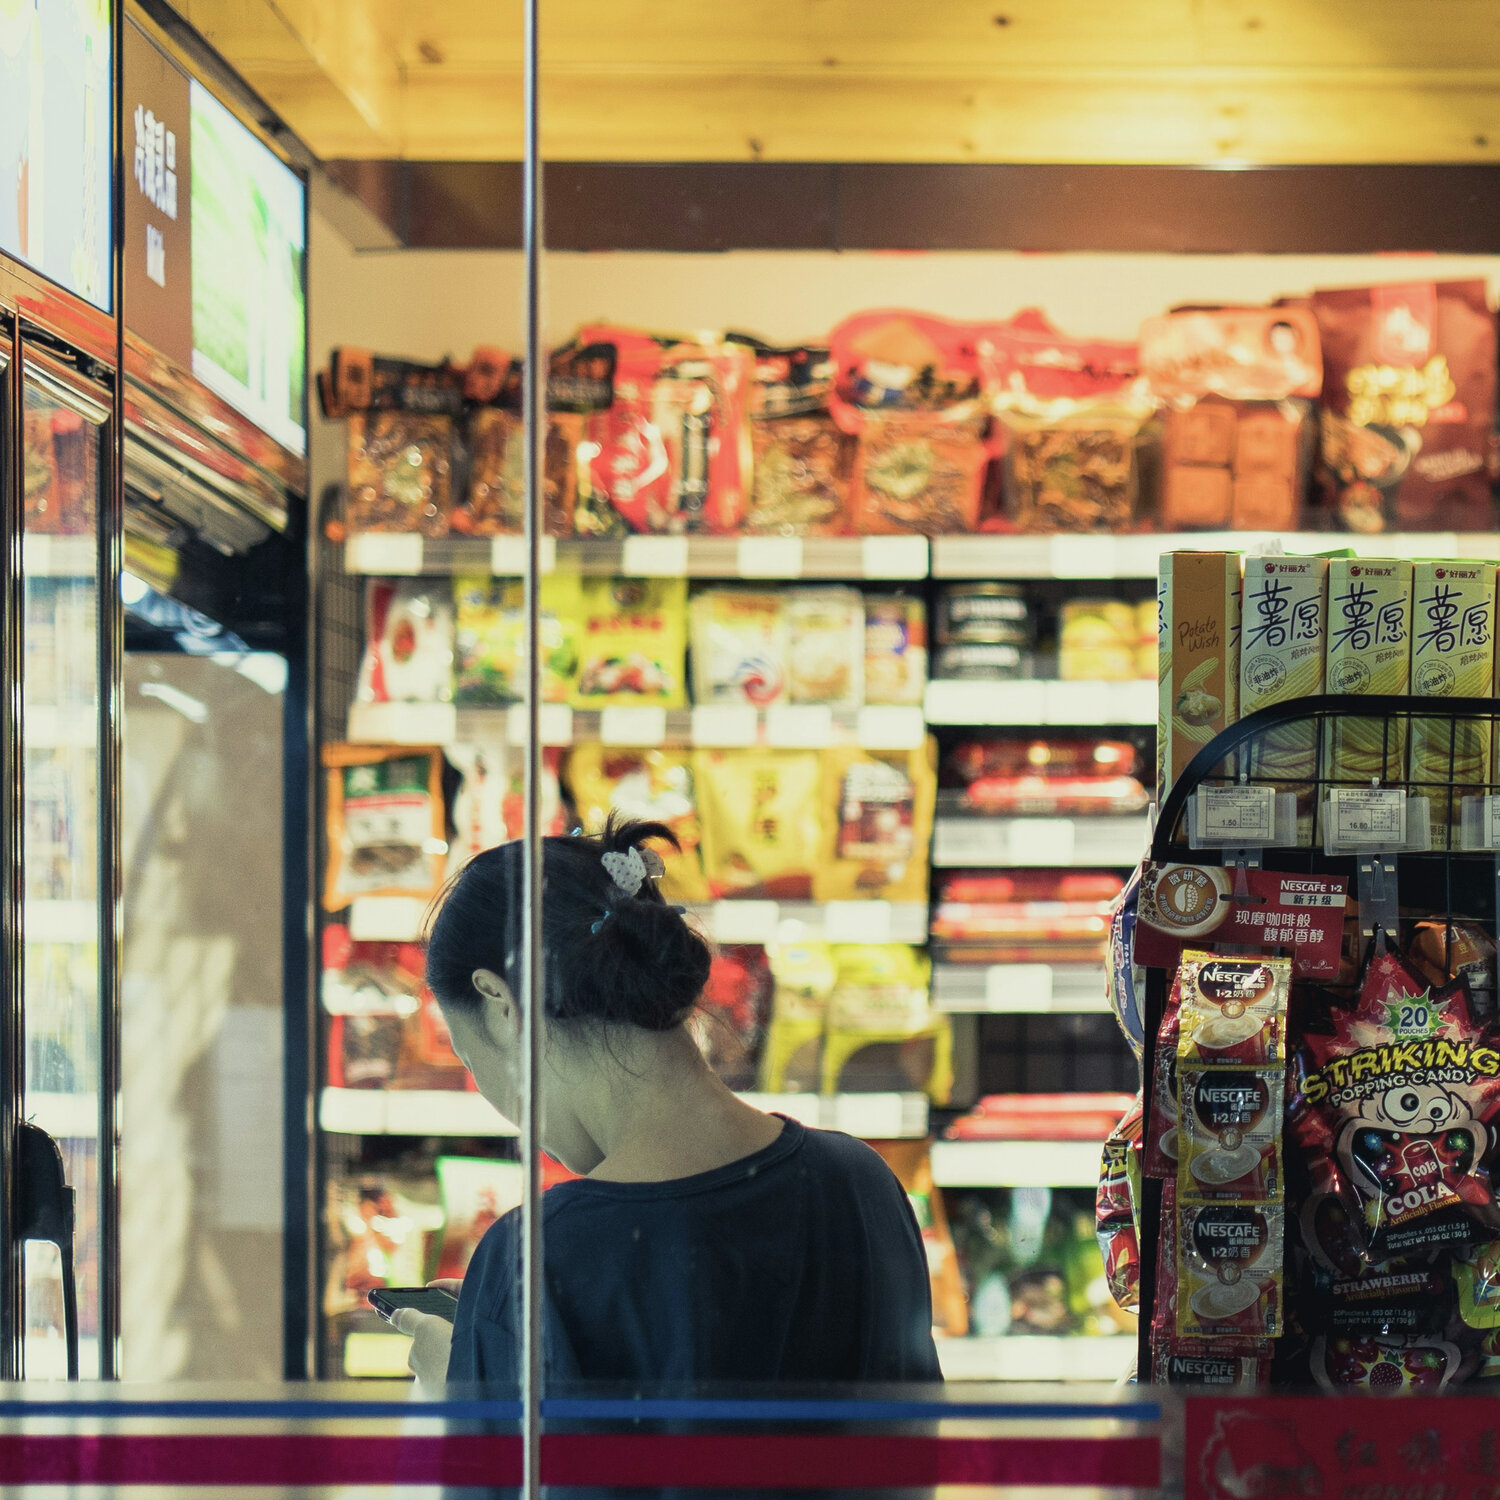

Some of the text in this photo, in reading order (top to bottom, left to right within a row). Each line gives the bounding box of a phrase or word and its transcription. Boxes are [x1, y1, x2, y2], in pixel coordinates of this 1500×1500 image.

[1246, 579, 1322, 650] 薯愿
[1331, 582, 1407, 652] 薯愿
[1416, 584, 1491, 655] 薯愿
[1178, 615, 1216, 645] Potato
[1188, 635, 1219, 652] Wish
[1168, 870, 1209, 888] 微研磨
[1280, 879, 1326, 892] NESCAFE
[1293, 894, 1333, 905] 新升级
[1235, 910, 1311, 928] 现磨咖啡般
[1264, 927, 1324, 943] 馥郁香醇
[1400, 1006, 1428, 1027] 20
[1399, 1027, 1428, 1035] POUCHES
[1301, 1041, 1500, 1104] STRIKING
[1199, 1089, 1261, 1102] NESCAFE
[1332, 1069, 1477, 1108] POPPING CANDY
[1413, 1160, 1437, 1177] cola
[1386, 1180, 1453, 1216] COLA
[1389, 1195, 1461, 1227] Artificially Flavored
[1198, 1223, 1260, 1237] NESCAFE
[1333, 1273, 1429, 1294] STRAWBERRY
[1173, 1359, 1235, 1376] NESCAFE
